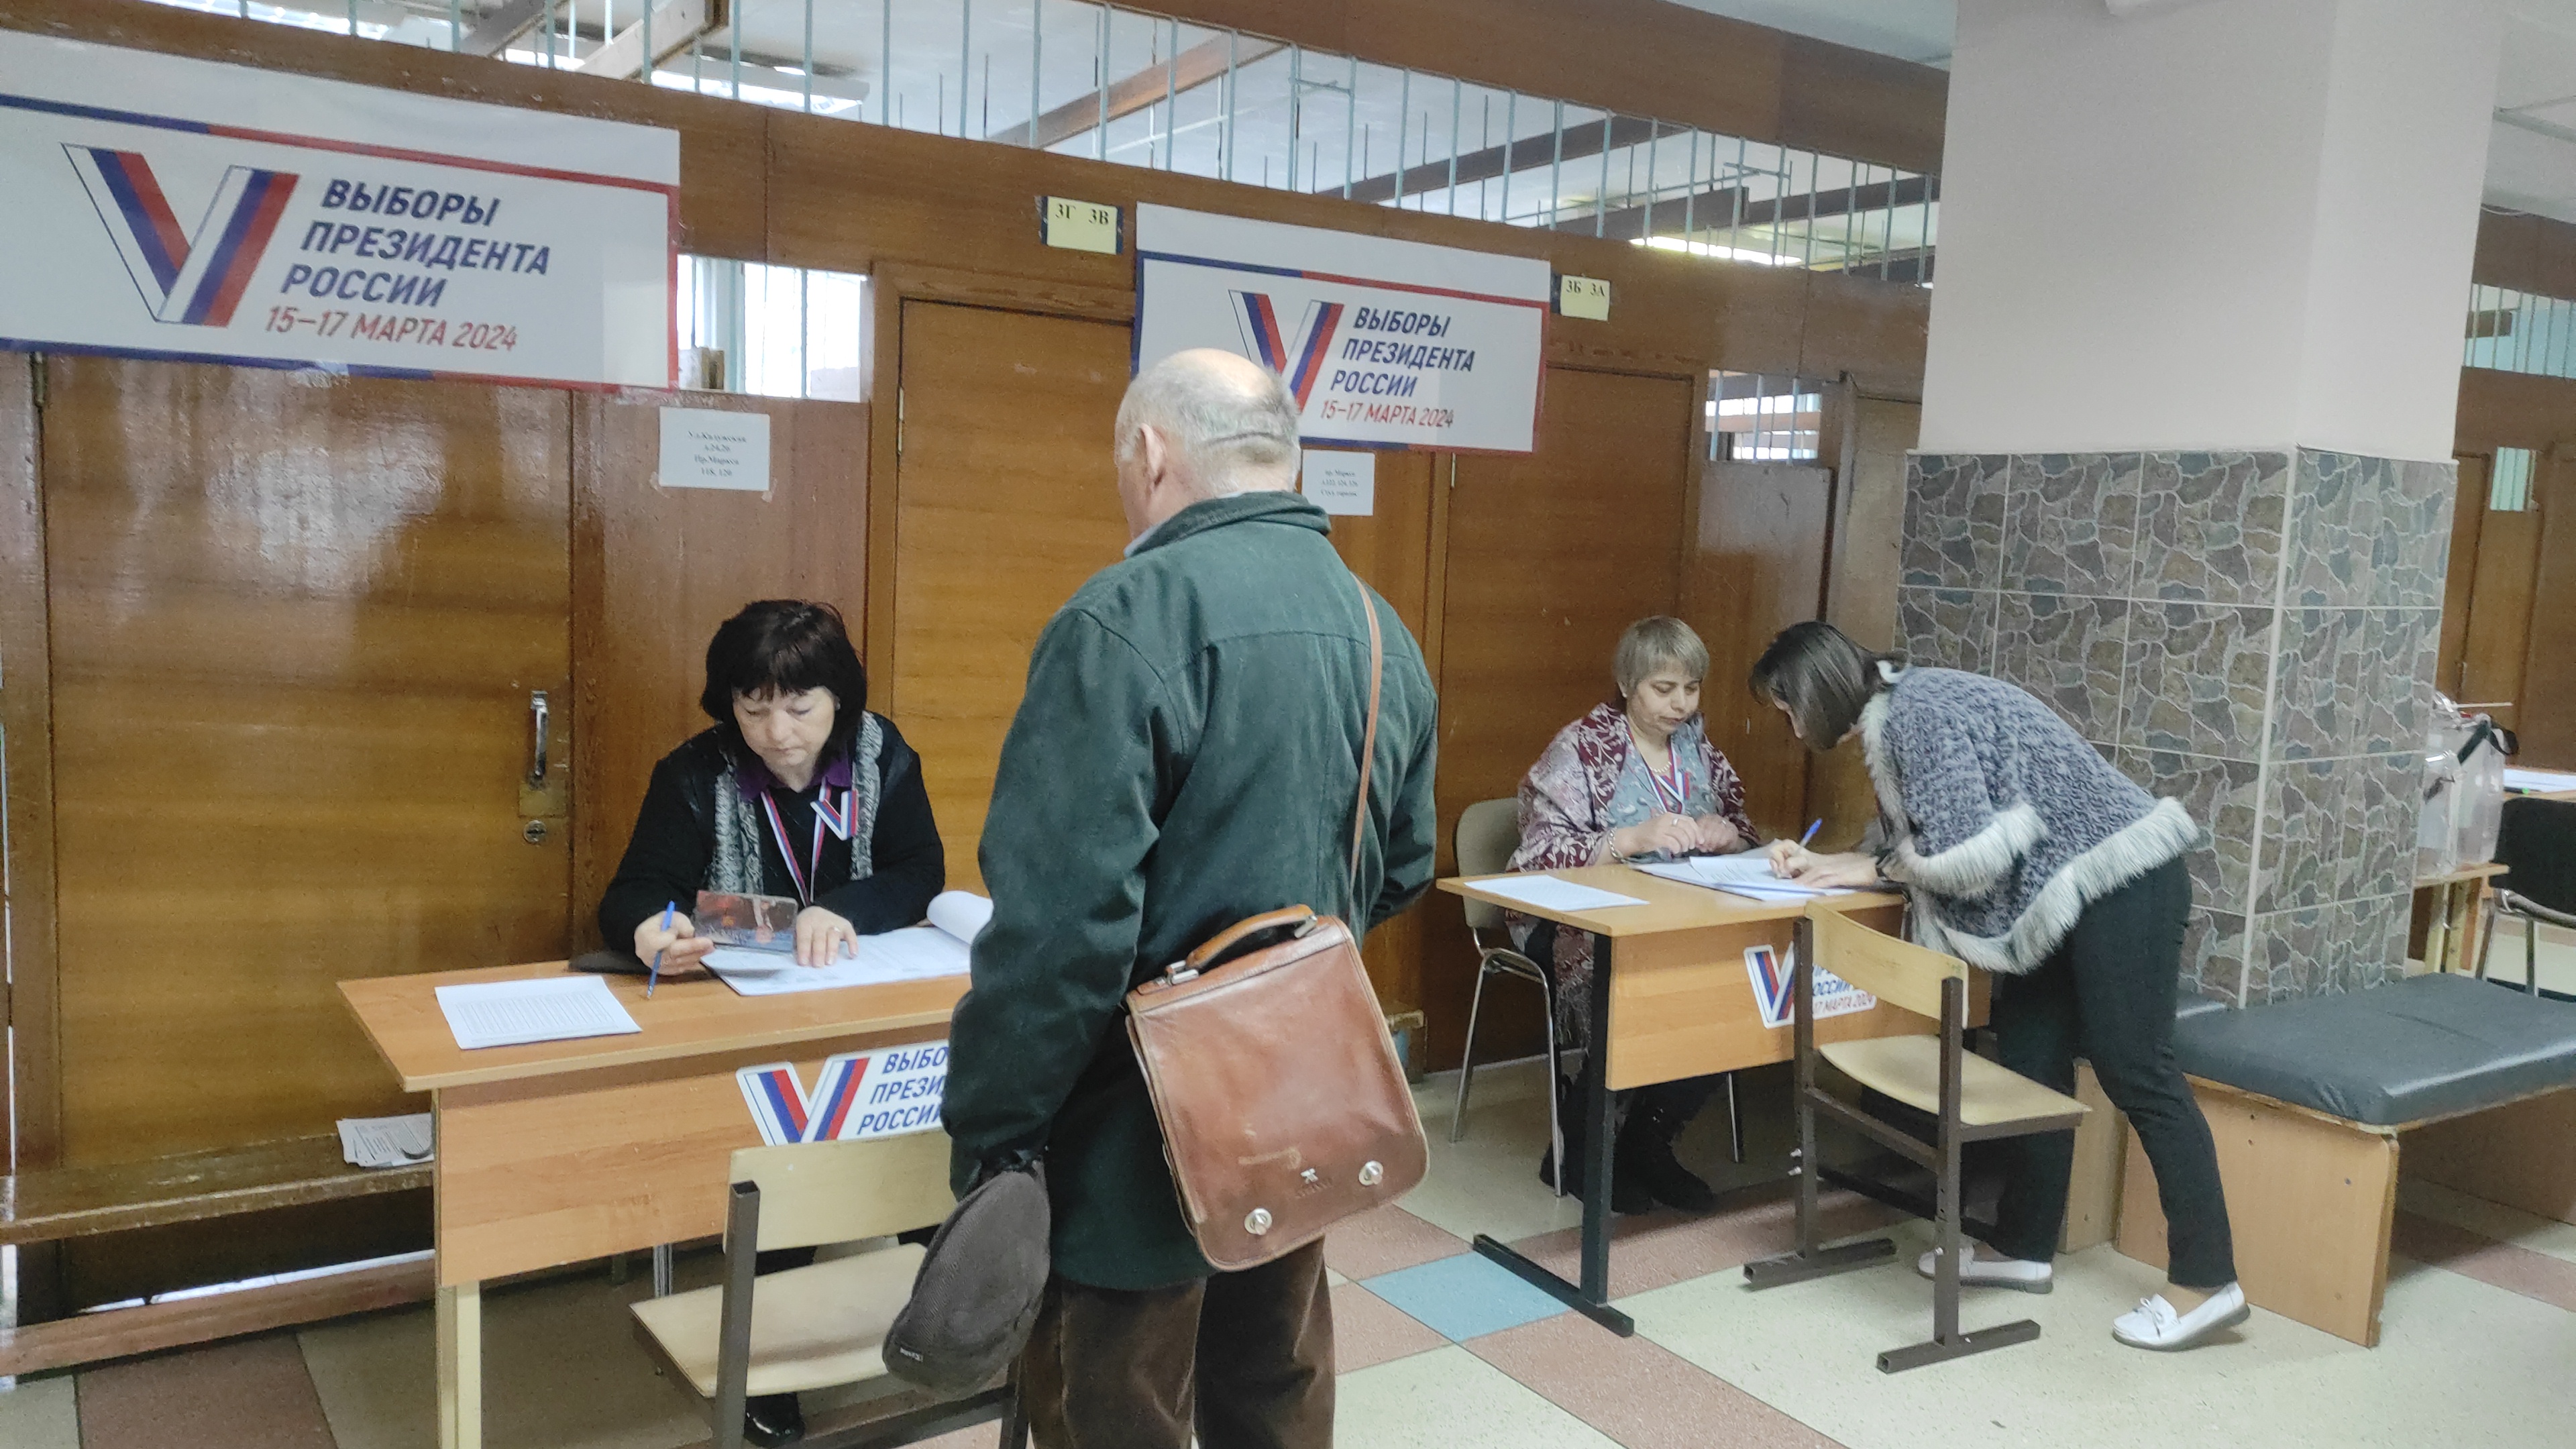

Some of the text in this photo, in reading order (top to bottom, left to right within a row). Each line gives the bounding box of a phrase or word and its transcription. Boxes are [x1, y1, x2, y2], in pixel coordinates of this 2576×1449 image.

[320, 178, 501, 227] ВЫБОРЫ
[300, 220, 551, 276] ПРЕЗИДЕНТА
[280, 263, 448, 307] РОССИИ
[350, 312, 447, 346] МАРТА
[452, 322, 518, 351] 2024
[1353, 306, 1451, 337] ВЫБОРЫ
[1342, 337, 1476, 372] ПРЕЗИДЕНТА
[1330, 370, 1417, 397] РОССИИ
[1364, 403, 1416, 425] МАРТА
[1419, 408, 1454, 427] 2024
[882, 1046, 949, 1074] ВЫБО
[869, 1075, 946, 1104] ПРЕЗИ
